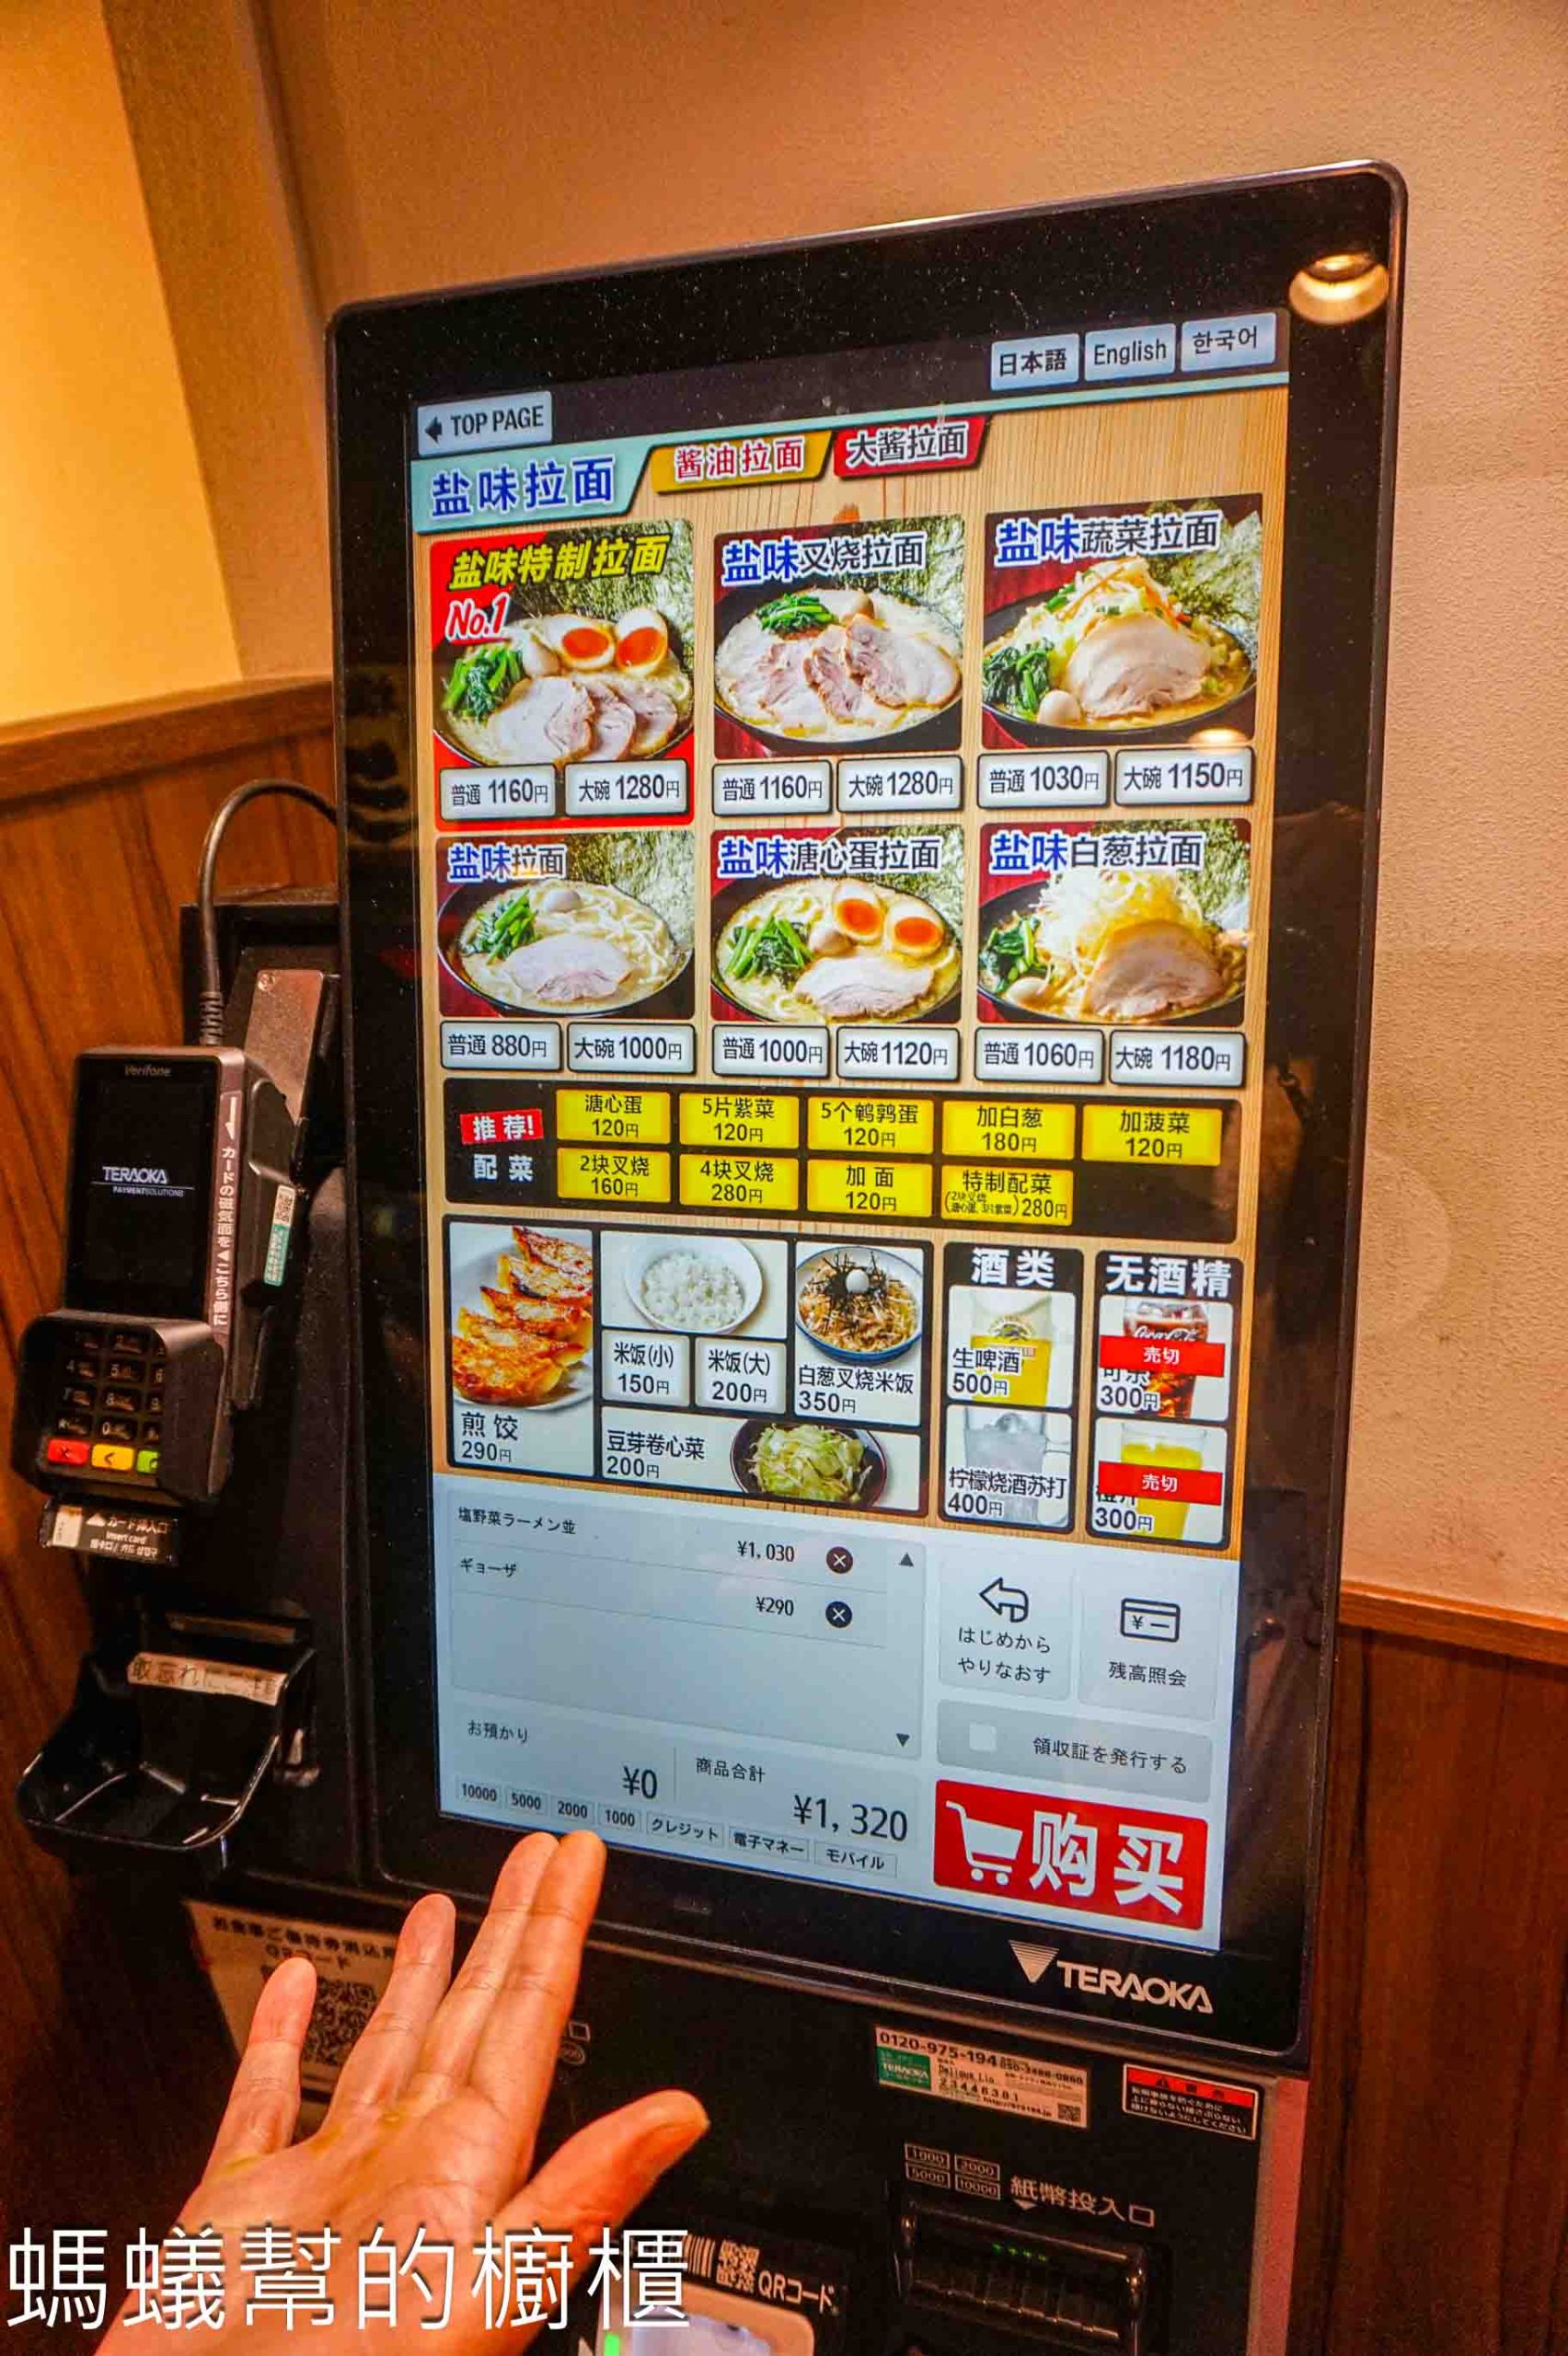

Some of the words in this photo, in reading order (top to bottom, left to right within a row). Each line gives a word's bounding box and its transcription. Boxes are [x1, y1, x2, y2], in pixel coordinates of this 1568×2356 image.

[1093, 338, 1167, 366] English
[1193, 326, 1258, 355] 한국어
[999, 348, 1067, 376] 日本語
[450, 413, 489, 436] TOP
[493, 405, 544, 432] PAGE
[847, 421, 969, 468] 大酱拉面
[674, 438, 805, 480] 酱油拉面
[432, 456, 615, 517] 盐味拉面
[996, 510, 1221, 566] 盐味蔬菜拉面
[448, 535, 672, 591] 盐味特制拉面
[722, 532, 926, 584] 盐味叉烧拉面
[445, 592, 510, 641] No.1
[579, 780, 610, 803] 大碗
[615, 774, 680, 800] 1280円
[722, 778, 755, 802] 普通
[759, 774, 823, 800] 1160円
[848, 774, 883, 799] 大碗
[886, 770, 953, 795] 1280円
[989, 769, 1024, 793] 普通
[1030, 765, 1099, 792] 1030円
[1124, 766, 1162, 791] 大碗
[1168, 761, 1244, 791] 1150円
[450, 784, 480, 806] 普通
[488, 777, 548, 803] 1160円
[448, 844, 567, 881] 盐味拉面
[718, 837, 940, 877] 盐味溏心蛋拉面
[989, 833, 1204, 872] 盐味白葱拉面
[447, 1034, 486, 1058] 普通
[491, 1034, 548, 1058] 880円
[573, 1035, 615, 1060] 大碗
[618, 1036, 683, 1061] 1000円
[722, 1037, 755, 1060] 普通
[759, 1039, 823, 1063] 1000円
[844, 1041, 878, 1064] 大碗
[882, 1042, 948, 1066] 1120円
[983, 1042, 1019, 1065] 普通
[1025, 1041, 1094, 1069] 1060円
[1115, 1046, 1153, 1070] 大碗
[1161, 1045, 1231, 1072] 1180円
[584, 1094, 642, 1114] 溏心蛋
[701, 1096, 775, 1120] 5片紫菜
[976, 1104, 1043, 1129] 加白葱
[473, 1114, 535, 1140] 推荐!
[592, 1118, 640, 1138] 120円
[713, 1122, 764, 1143] 120円
[1120, 1110, 1191, 1134] 加菠菜
[844, 1127, 895, 1148] 120円
[982, 1132, 1037, 1152] 180円
[1125, 1138, 1183, 1160] 120円
[102, 1166, 167, 1184] TERAOKA
[473, 1153, 535, 1183] 配菜
[580, 1155, 650, 1177] 2块叉烧
[700, 1160, 775, 1183] 4块叉烧
[847, 1164, 894, 1188] 加面
[591, 1177, 639, 1197] 160円
[711, 1184, 763, 1204] 280円
[963, 1170, 1052, 1195] 特制配菜
[845, 1192, 896, 1212] 120円
[1021, 1197, 1067, 1218] 280円
[972, 1248, 1054, 1288] 酒类
[1106, 1254, 1231, 1297] 无酒精
[614, 1343, 674, 1368] 米饭(小)
[709, 1350, 770, 1376] 米饭(大)
[952, 1347, 1020, 1373] 生啤酒
[1144, 1346, 1180, 1364] 売切
[618, 1372, 669, 1396] 150円
[712, 1381, 767, 1403] 200円
[799, 1364, 914, 1395] 白葱叉烧米饭
[952, 1372, 1008, 1396] 500円
[799, 1391, 856, 1414] 350円
[1101, 1385, 1159, 1409] 300円
[462, 1412, 518, 1442] 煎饺
[462, 1442, 511, 1463] 290円
[606, 1429, 705, 1460] 豆芽卷心菜
[606, 1455, 659, 1479] 200円
[949, 1467, 1066, 1499] 柠檬烧酒苏打
[1142, 1473, 1178, 1492] 売切
[948, 1492, 1003, 1517] 400円
[458, 1507, 576, 1534] 塩野菜ラーメン並
[1096, 1507, 1153, 1531] 300円
[460, 1557, 516, 1578] ギョーザ
[756, 1596, 794, 1616] ¥290
[958, 1626, 1051, 1654] はじめから
[958, 1657, 1051, 1684] やりなおす
[1109, 1661, 1187, 1687] 残高照会
[467, 1719, 528, 1744] お預かり
[1033, 1737, 1187, 1774] 領収証を発行する
[622, 1766, 657, 1799] ¥0
[696, 1758, 766, 1784] 商品合計
[461, 1784, 497, 1802] 10000
[512, 1793, 541, 1810] 5000
[558, 1801, 587, 1819] 2000
[605, 1809, 635, 1827] 1000
[651, 1818, 719, 1841] クレジット
[733, 1831, 804, 1855] 電子マネー
[825, 1848, 884, 1869] モバイル
[1029, 1810, 1184, 1915] 购买
[1057, 1961, 1214, 2015] TERAOKA
[880, 2031, 997, 2068] 0120-975-194
[758, 2269, 838, 2314] QRコード
